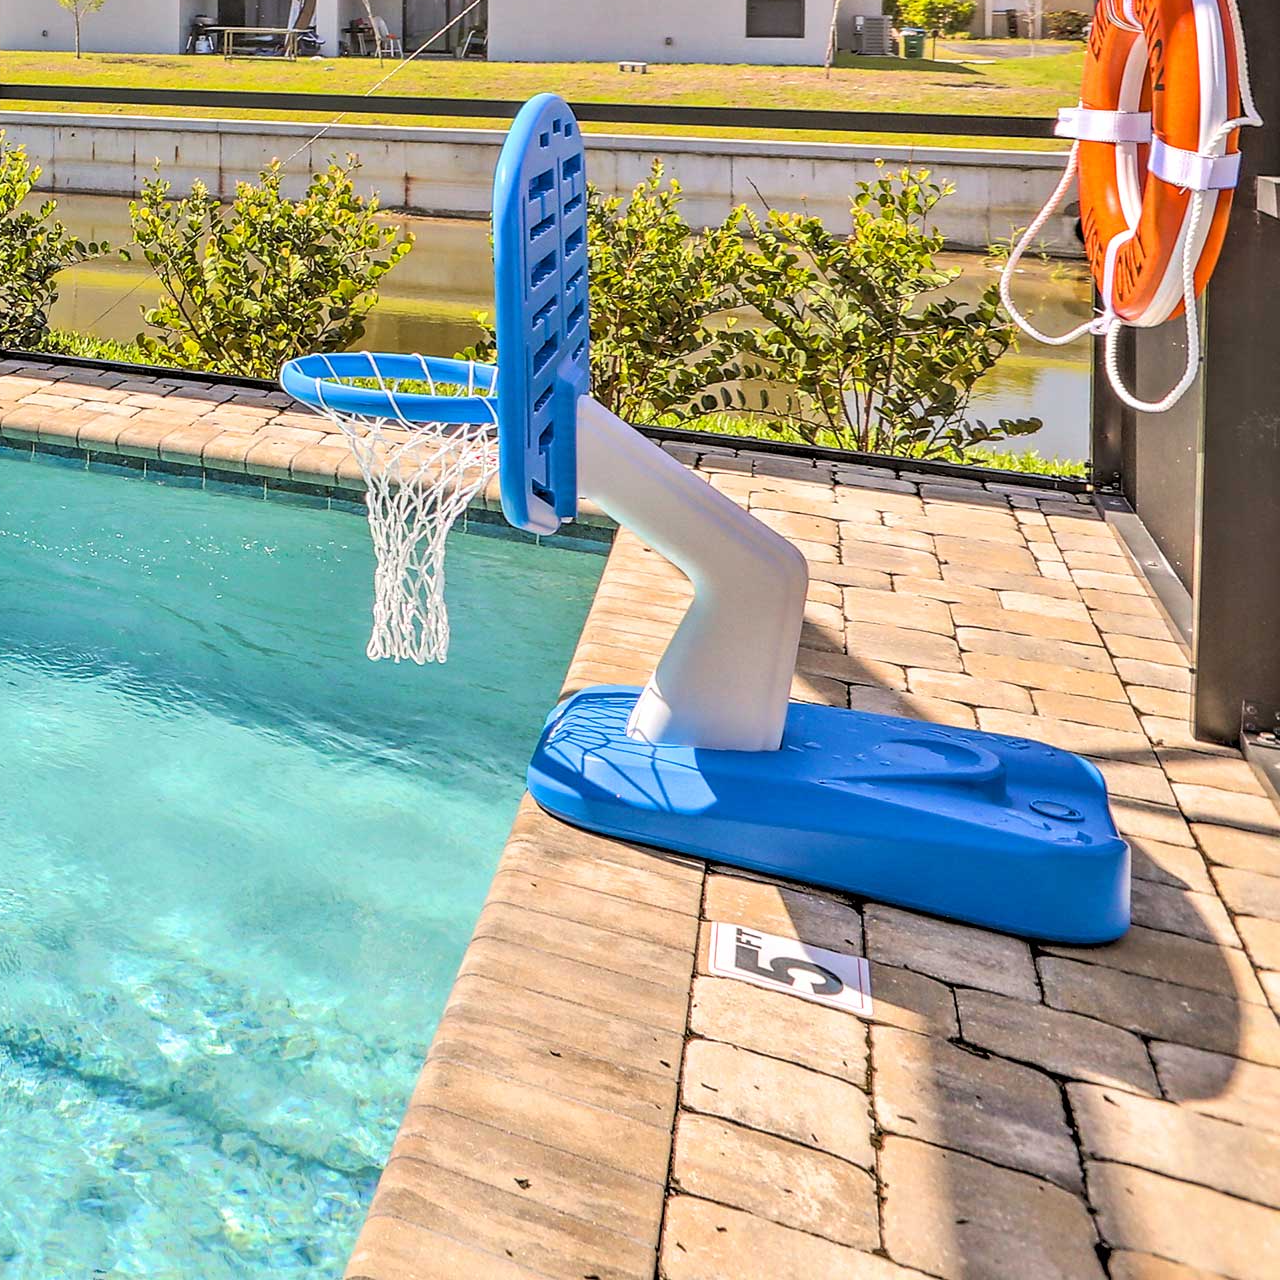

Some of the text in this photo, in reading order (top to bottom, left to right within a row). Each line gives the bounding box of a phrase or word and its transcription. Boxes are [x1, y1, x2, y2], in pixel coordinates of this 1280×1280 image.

[1115, 226, 1147, 302] ONLY
[735, 927, 843, 996] 5 FT
